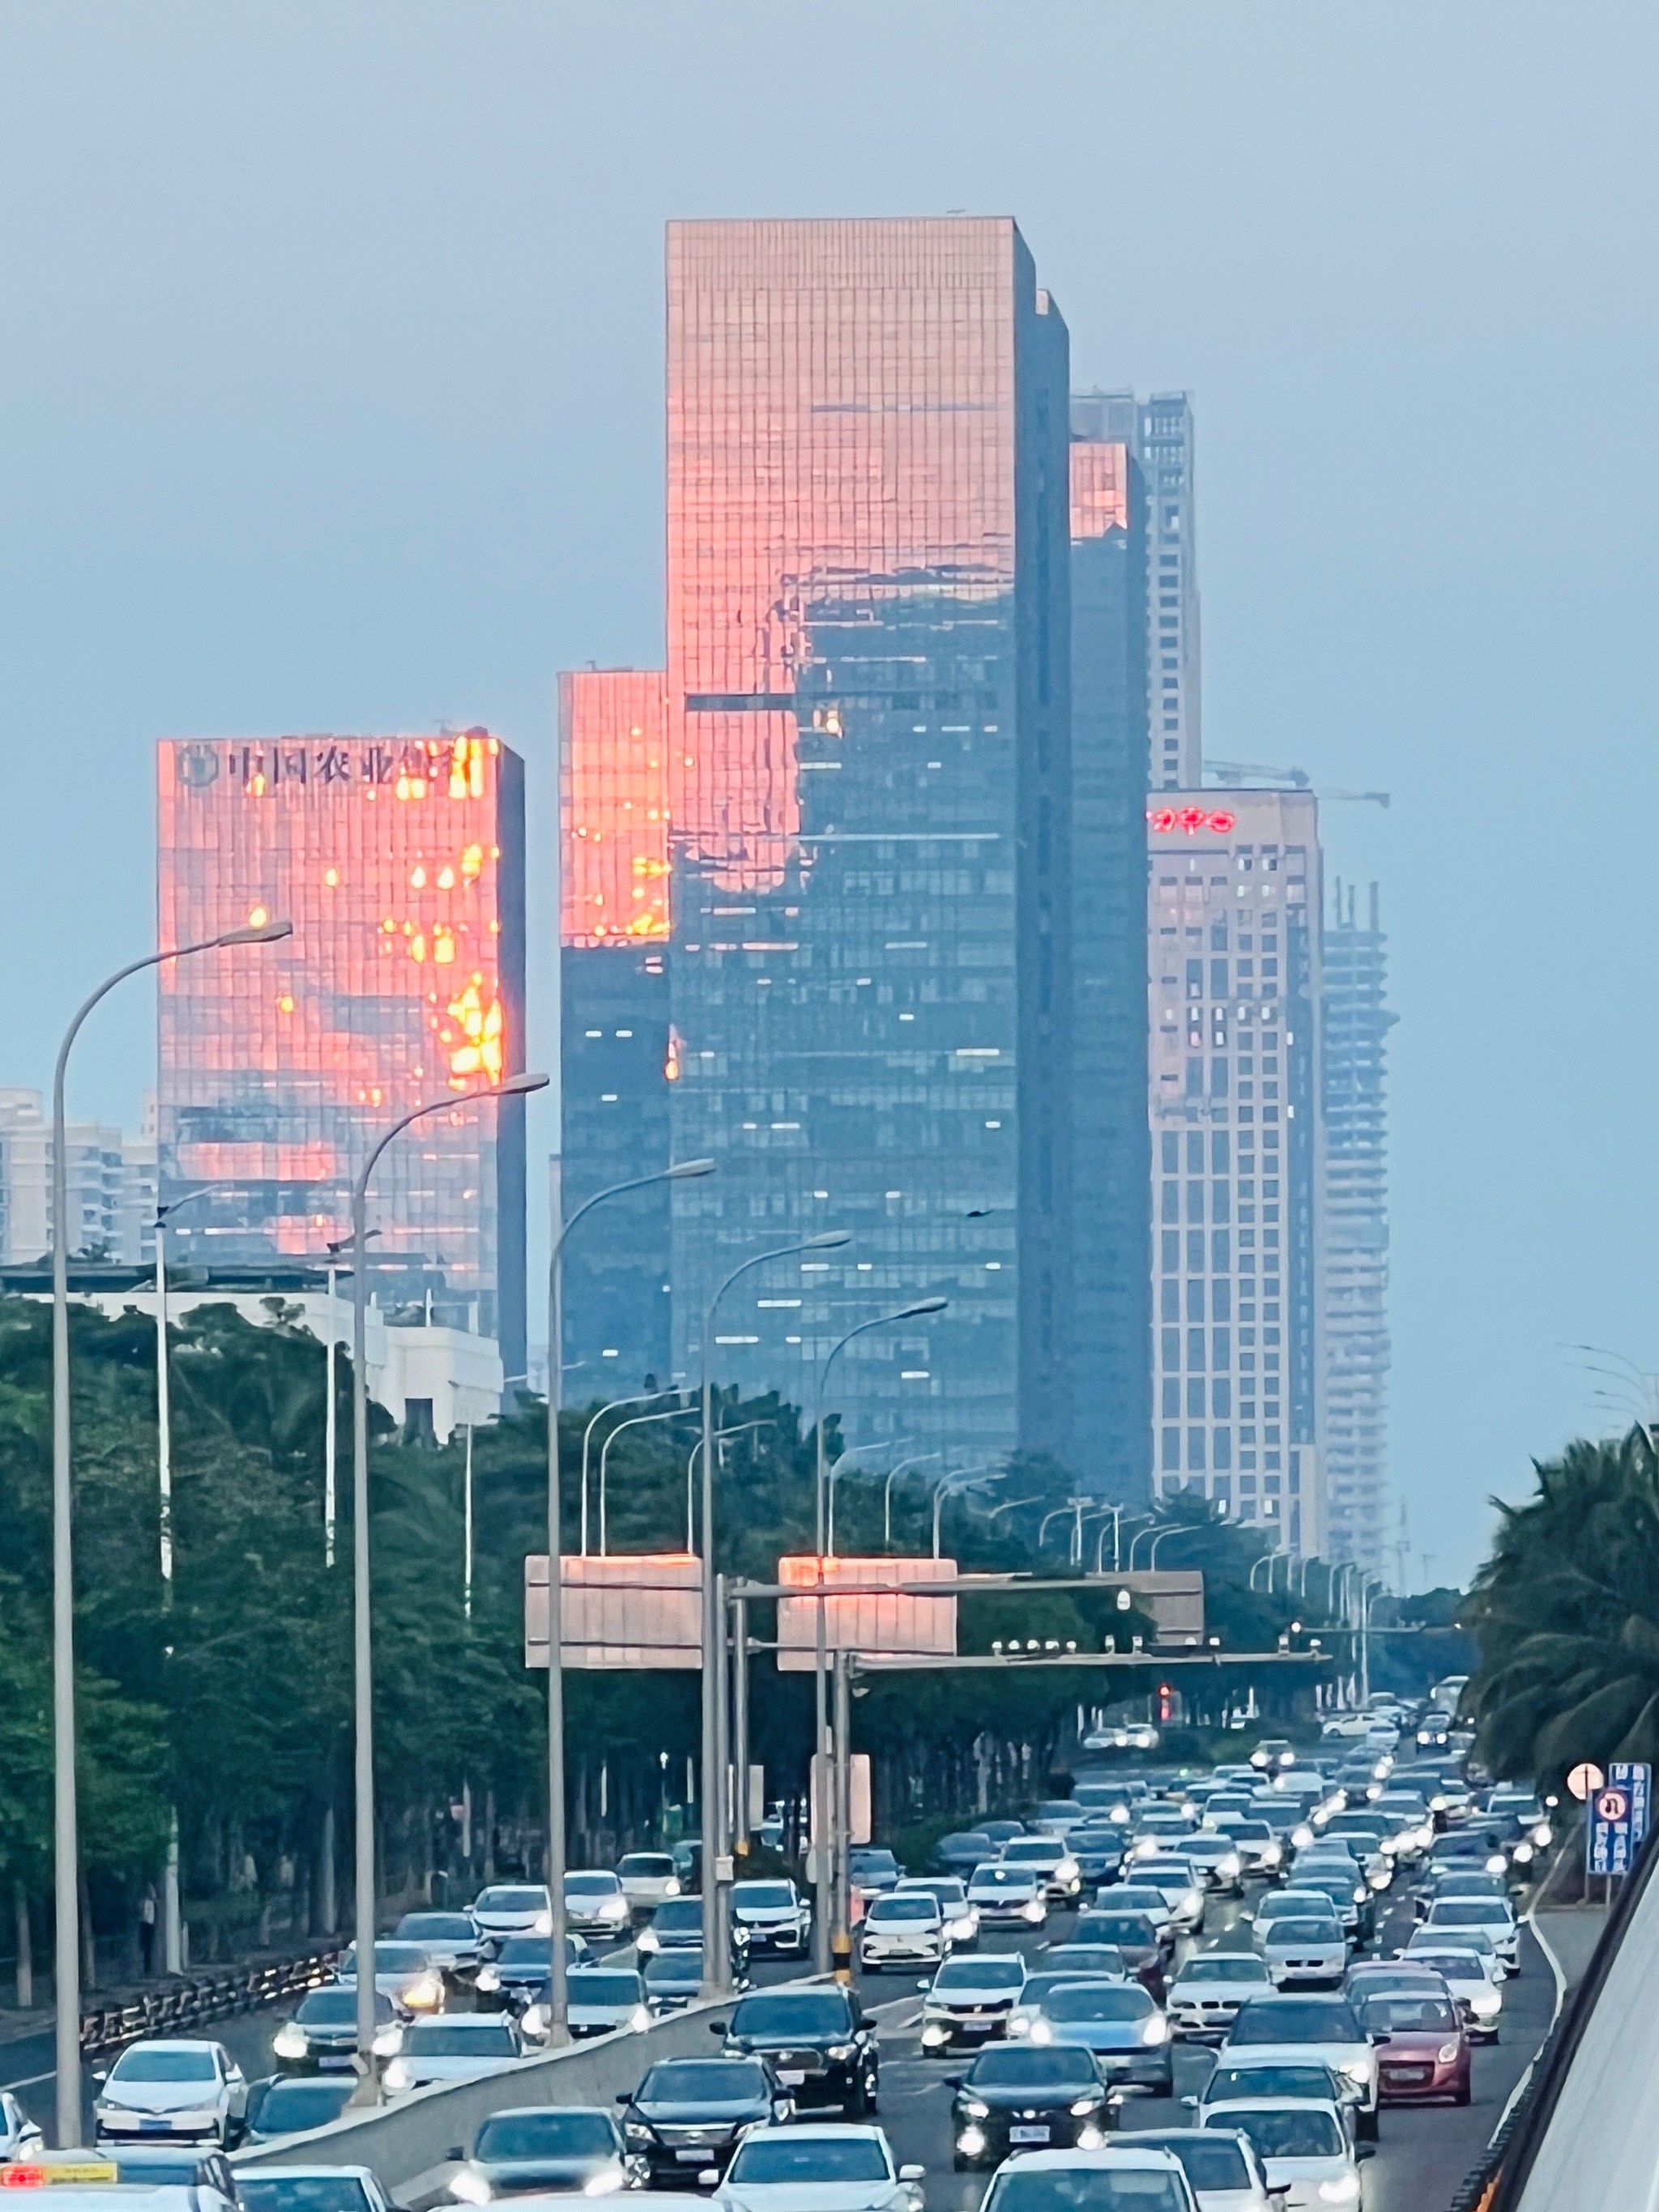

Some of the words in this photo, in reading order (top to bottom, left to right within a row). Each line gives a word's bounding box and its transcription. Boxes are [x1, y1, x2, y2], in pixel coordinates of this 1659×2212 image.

[228, 744, 480, 784] 中国农业银
